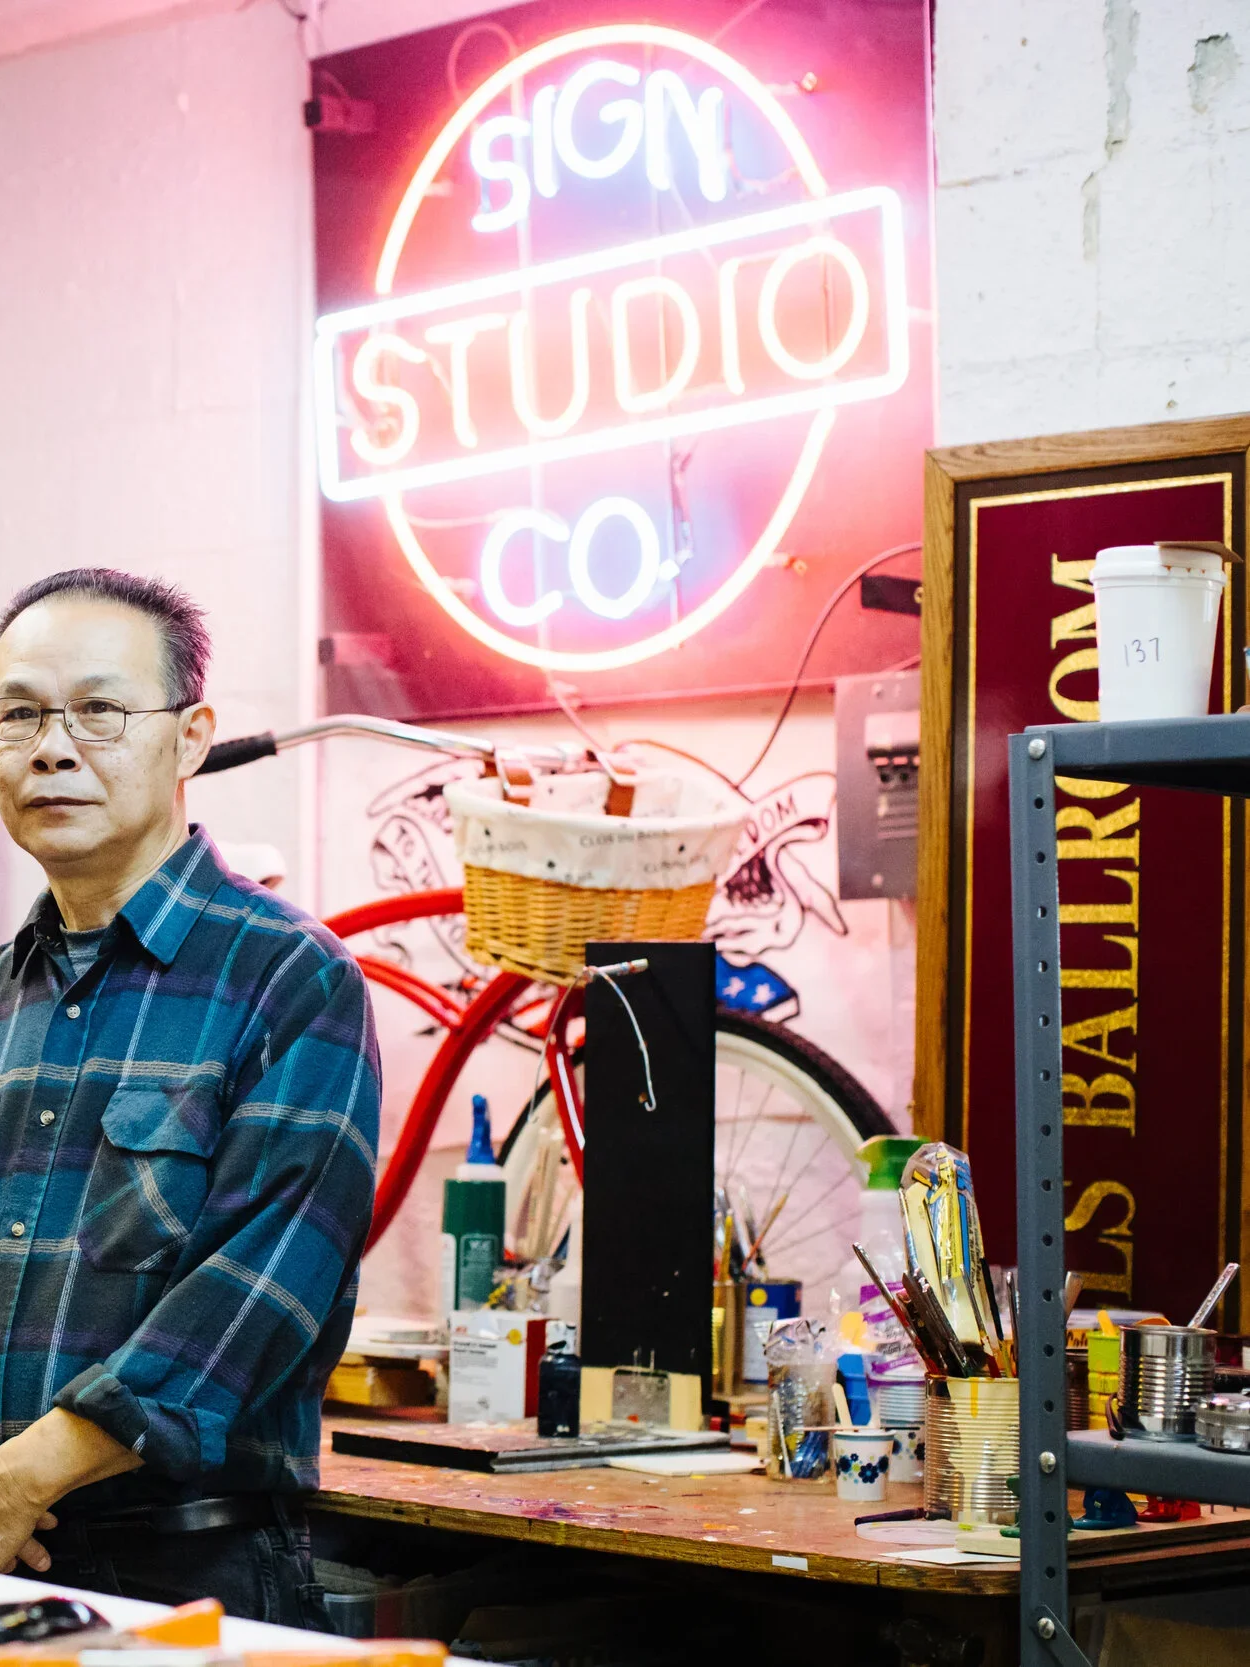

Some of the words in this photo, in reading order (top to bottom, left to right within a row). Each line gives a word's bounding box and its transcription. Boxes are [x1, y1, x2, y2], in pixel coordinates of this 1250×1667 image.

[469, 59, 728, 233] SIGN
[350, 235, 869, 465] STUDIO
[1122, 636, 1162, 668] 137
